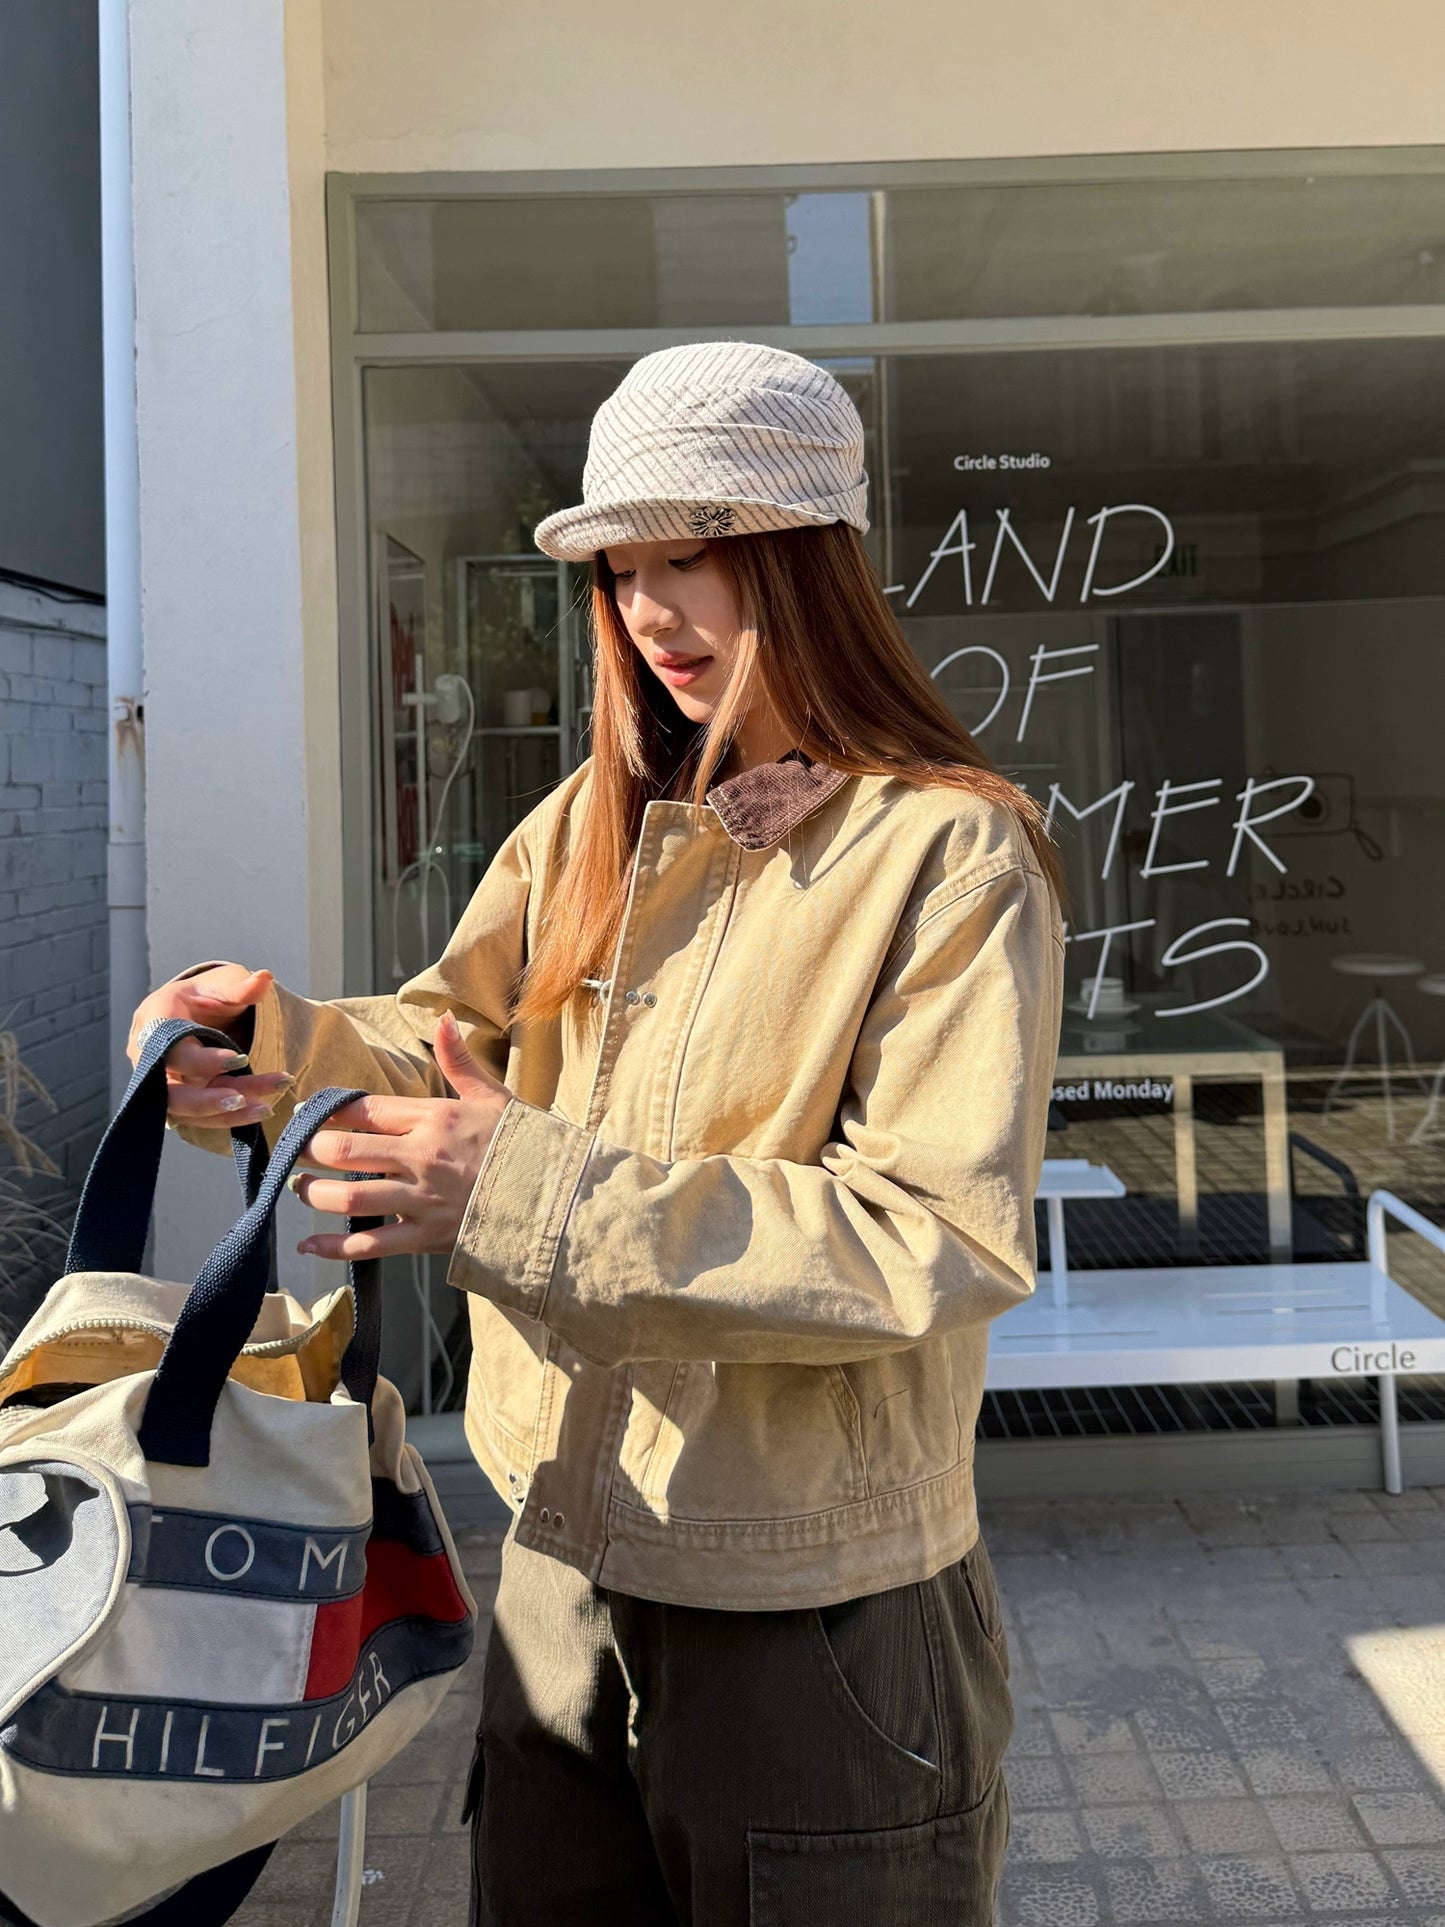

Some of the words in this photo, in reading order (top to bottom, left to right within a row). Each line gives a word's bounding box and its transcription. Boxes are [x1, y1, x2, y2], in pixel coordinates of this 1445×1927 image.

[953, 453, 997, 471] Circle
[999, 452, 1051, 470] Studio
[883, 504, 1175, 608] AND
[1016, 776, 1314, 879] MER
[1063, 918, 1270, 1020] TS
[1094, 1078, 1174, 1104] Monday
[1331, 1342, 1416, 1373] Circle
[151, 1514, 349, 1591] OM
[92, 1651, 392, 1777] HILFIGER
